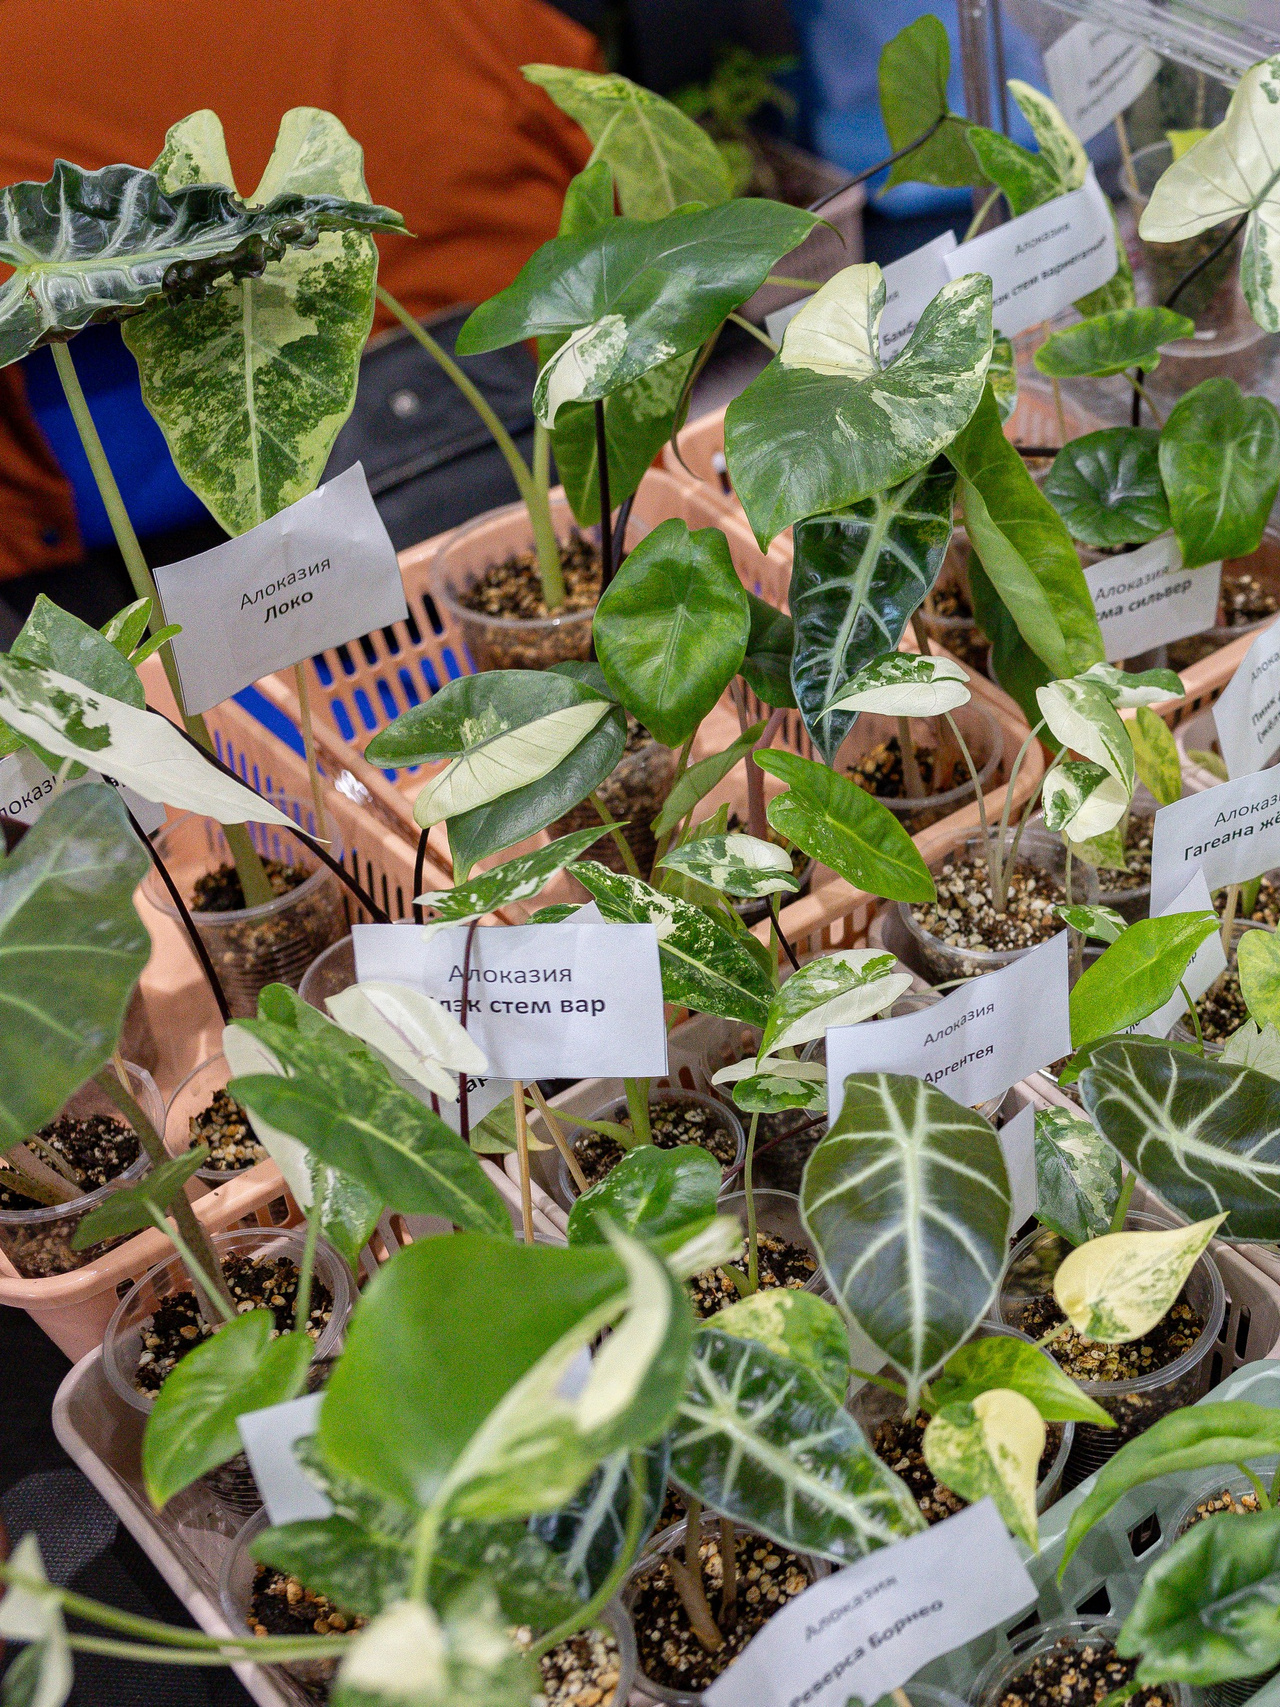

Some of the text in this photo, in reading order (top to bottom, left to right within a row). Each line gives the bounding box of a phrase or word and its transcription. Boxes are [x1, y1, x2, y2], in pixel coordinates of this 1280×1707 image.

[240, 558, 331, 611] Алоказия
[1095, 566, 1170, 602] Алоказия
[263, 591, 314, 624] Локо
[1184, 825, 1254, 861] Гагеана
[448, 964, 573, 984] Алоказия
[489, 1000, 552, 1015] стем
[560, 998, 606, 1017] вар
[923, 1002, 995, 1047] Алоказия
[923, 1044, 995, 1084] Аргентея
[805, 1575, 897, 1642] Алоказия
[868, 1599, 944, 1650] Борнео
